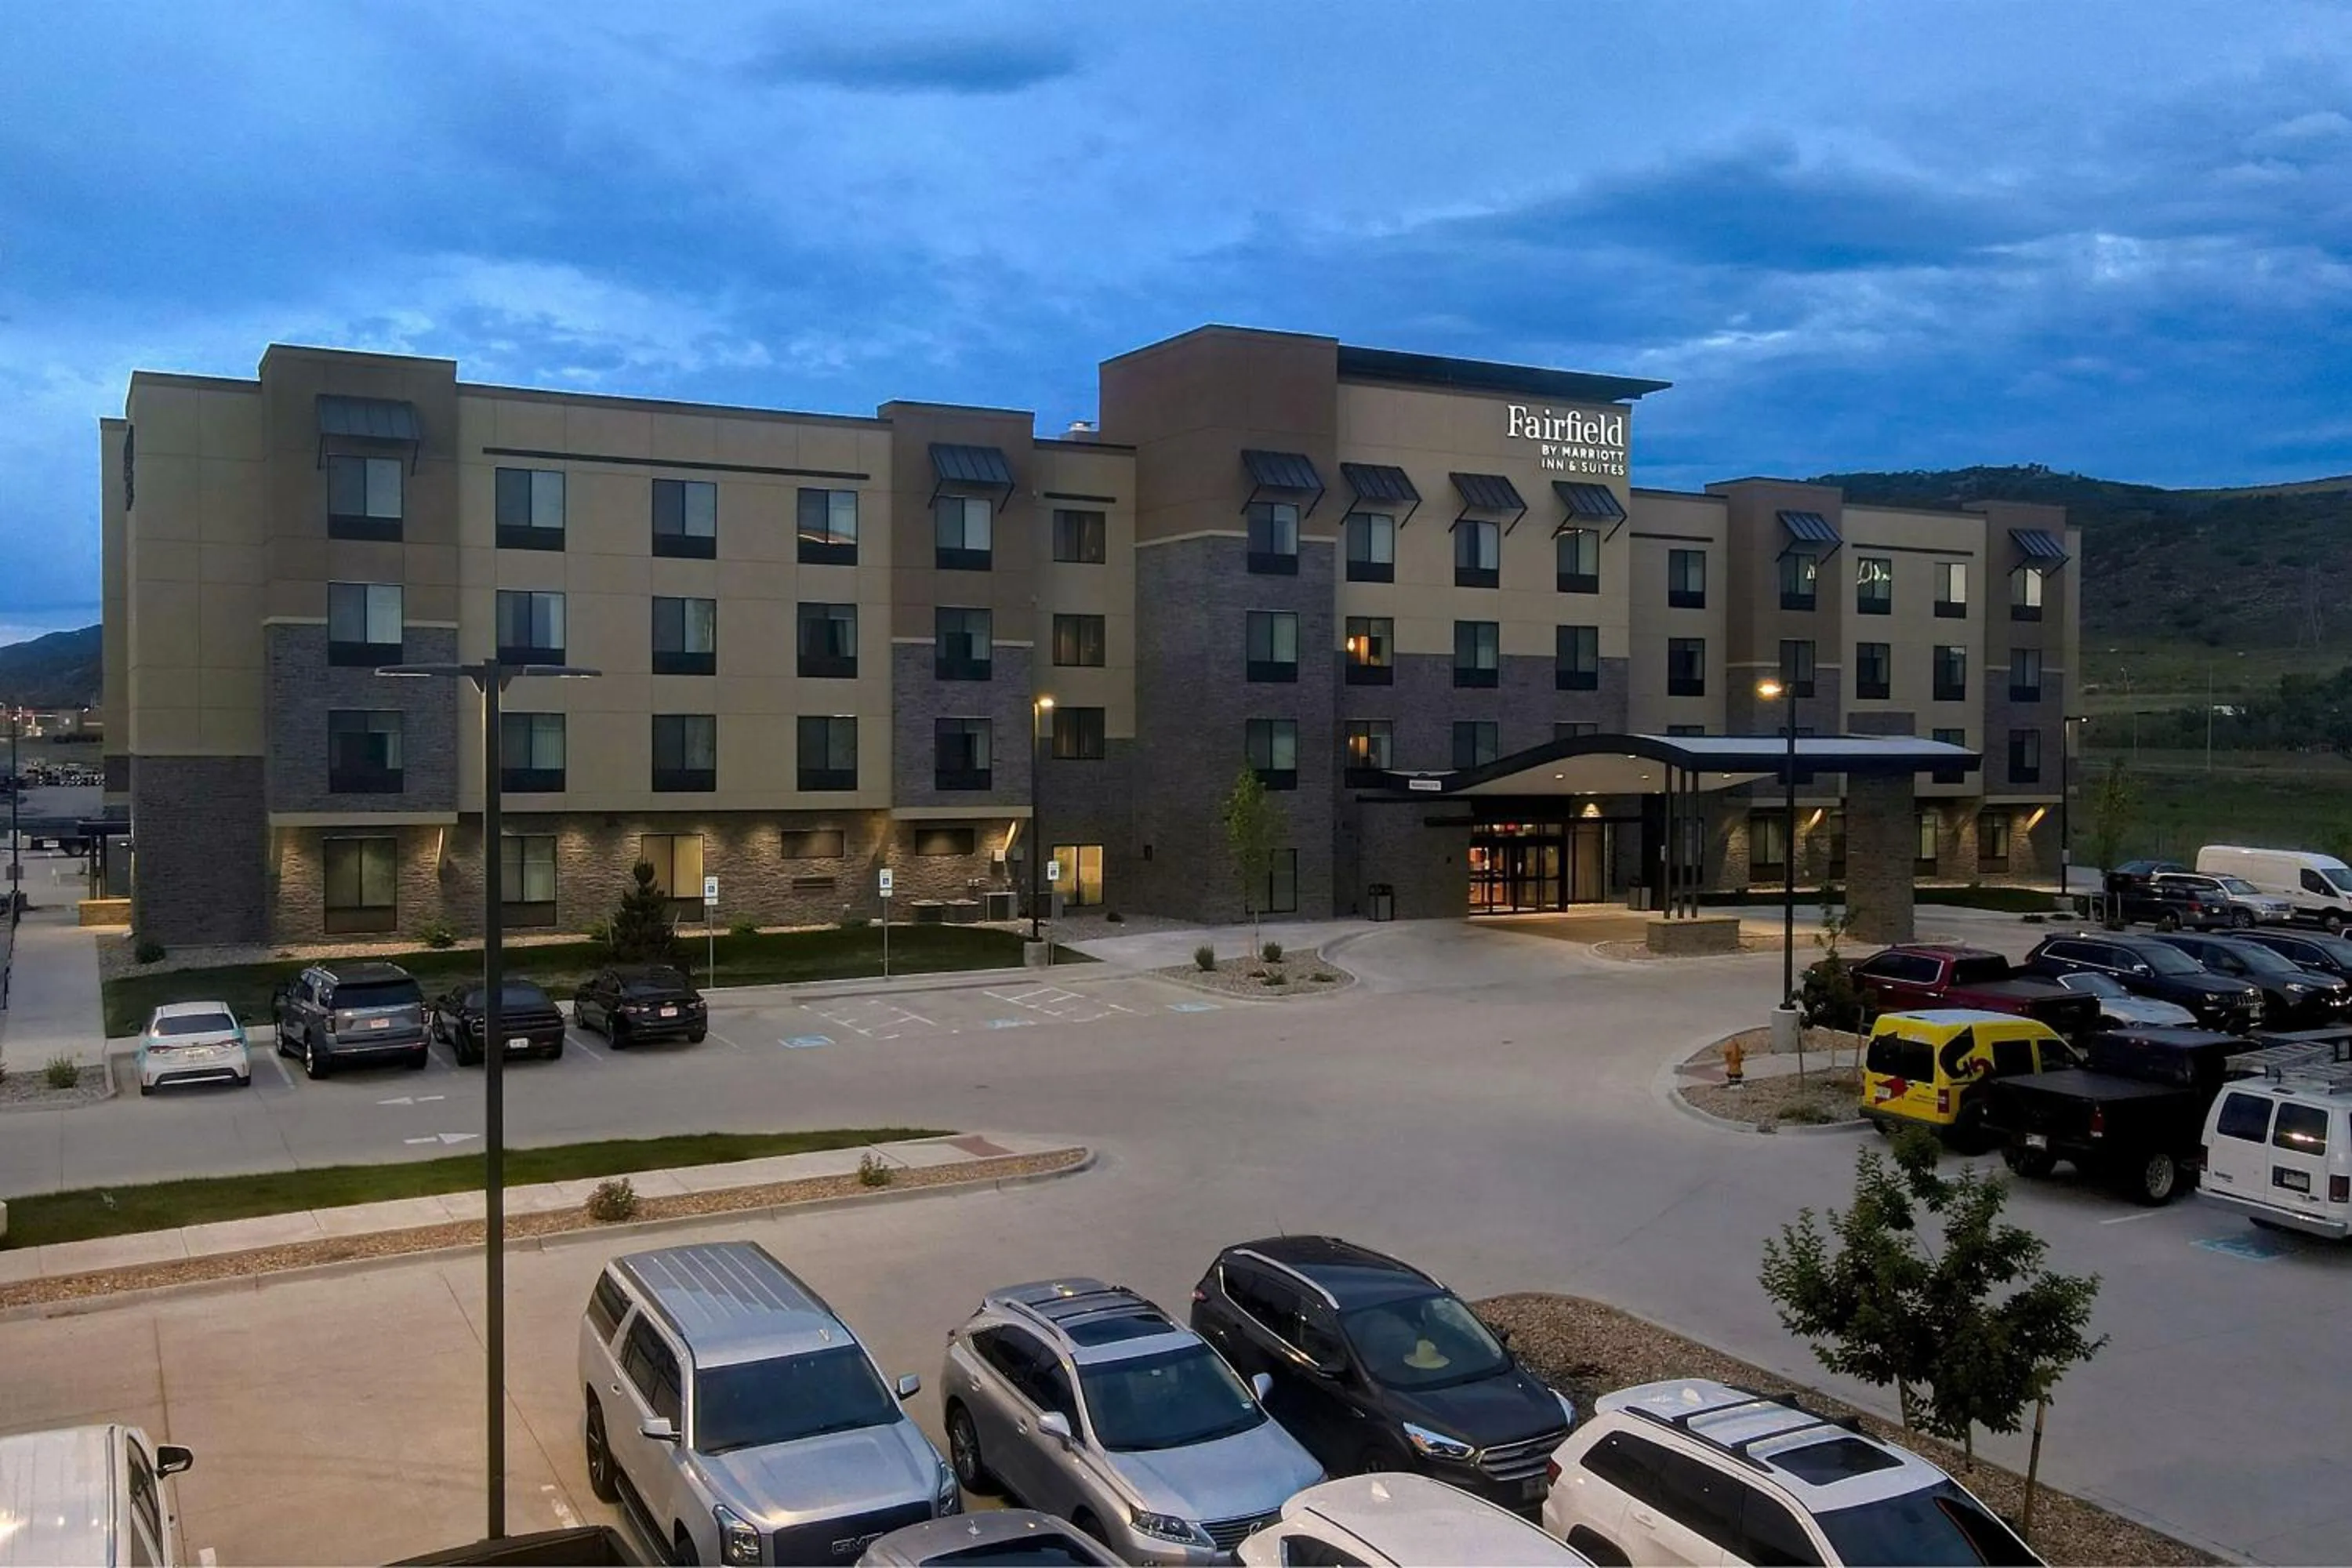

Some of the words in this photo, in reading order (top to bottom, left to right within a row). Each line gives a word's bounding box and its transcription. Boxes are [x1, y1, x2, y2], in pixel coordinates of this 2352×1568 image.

[1507, 405, 1624, 447] Fairfield
[1542, 445, 1557, 456] BY
[1563, 447, 1624, 463] MARRIOTT
[1541, 459, 1564, 471] INN
[1569, 460, 1577, 471] &
[1581, 462, 1624, 476] SUITES
